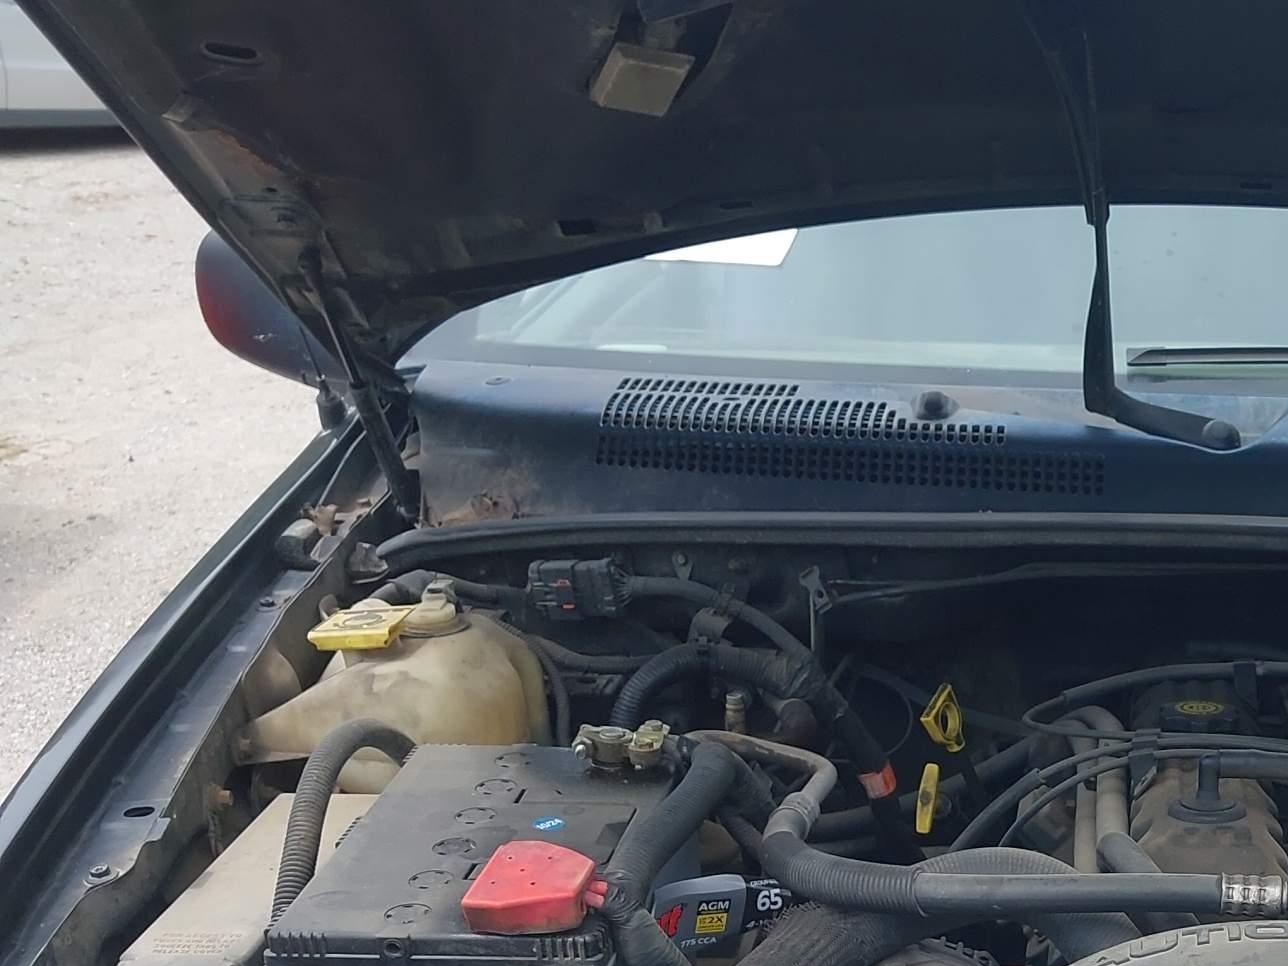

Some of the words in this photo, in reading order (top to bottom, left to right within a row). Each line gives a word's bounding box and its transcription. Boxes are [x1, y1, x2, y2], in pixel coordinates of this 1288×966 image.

[756, 888, 783, 911] 65
[698, 900, 730, 912] AGM
[697, 936, 717, 946] CCA
